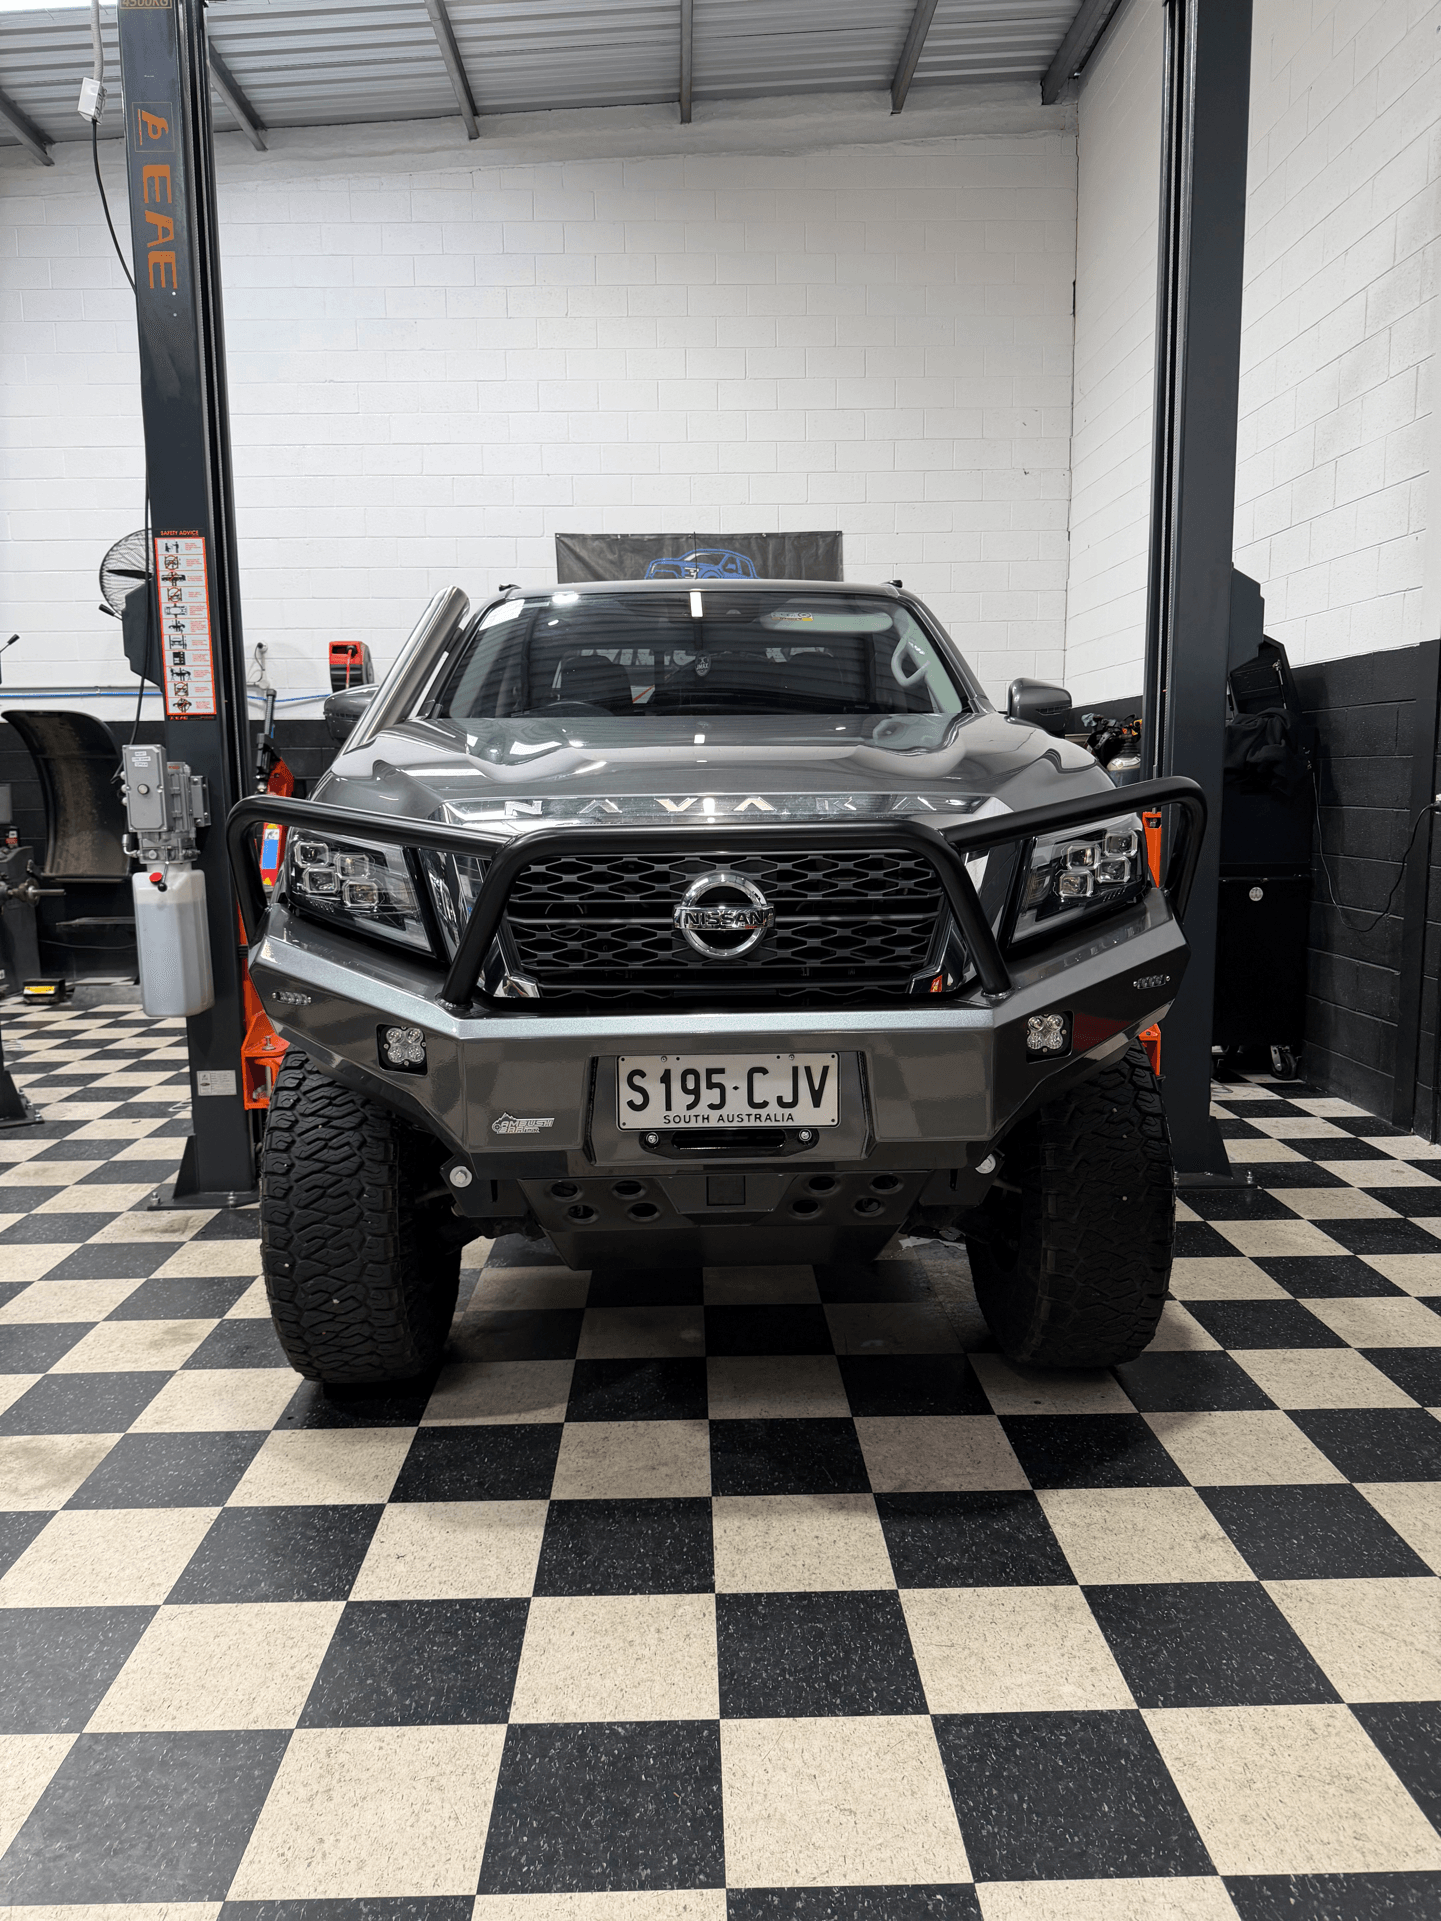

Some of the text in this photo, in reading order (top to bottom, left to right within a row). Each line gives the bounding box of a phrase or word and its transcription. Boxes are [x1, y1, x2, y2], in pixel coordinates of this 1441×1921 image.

[504, 797, 937, 816] NAVARA
[685, 910, 765, 926] NISSAN
[500, 1119, 554, 1128] AMBUSH
[663, 1112, 795, 1124] SOUTH AUSTRALIA
